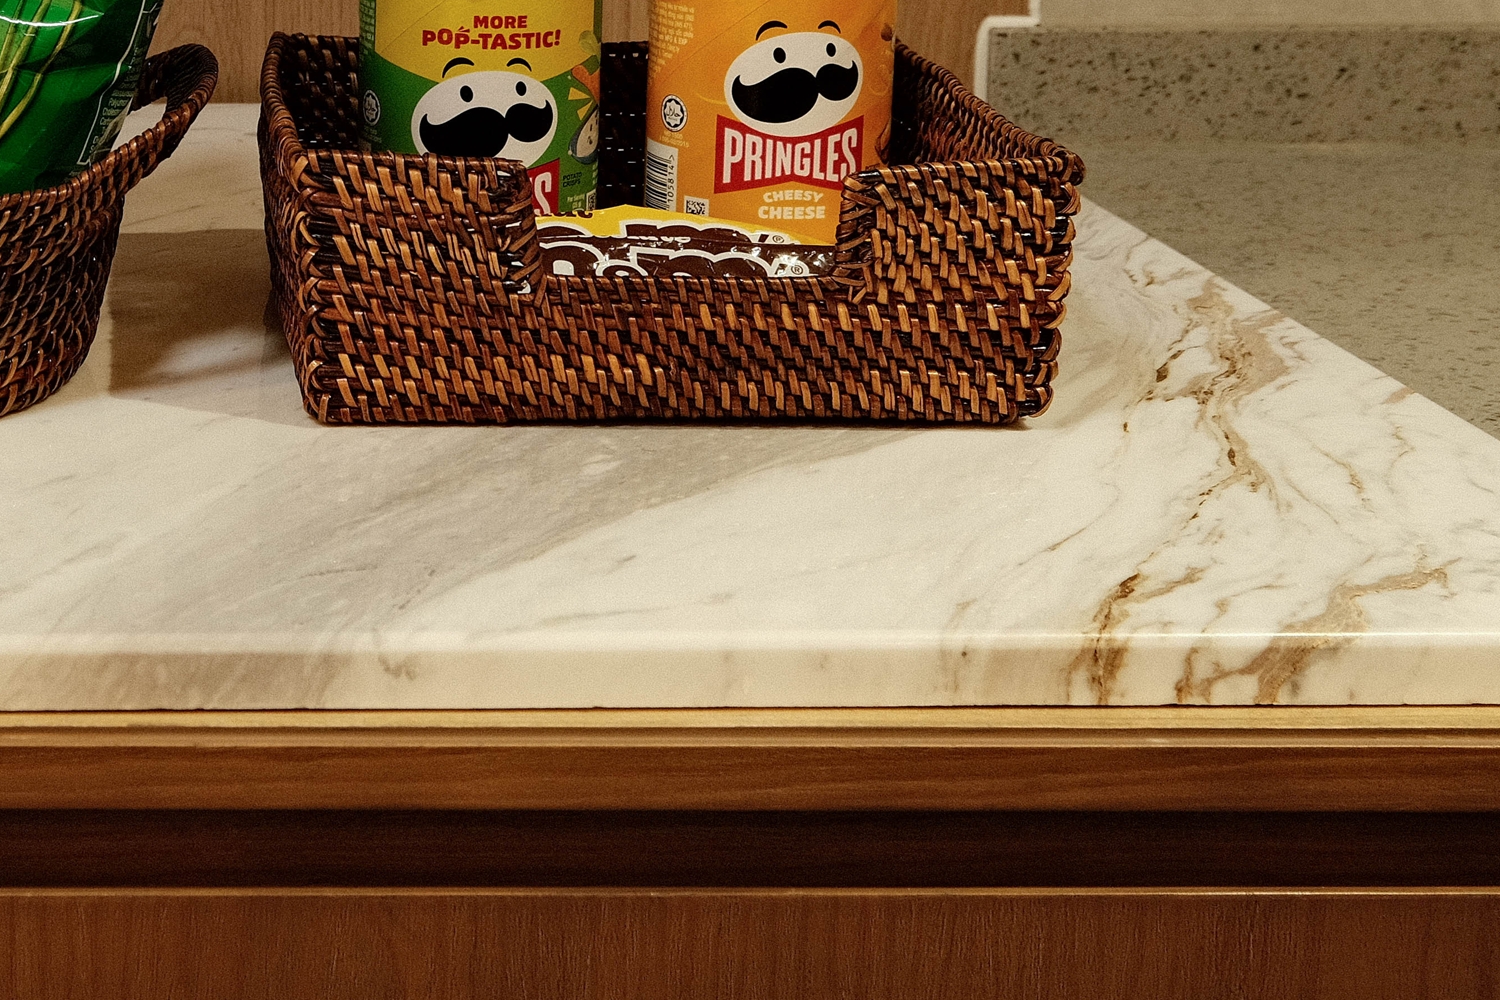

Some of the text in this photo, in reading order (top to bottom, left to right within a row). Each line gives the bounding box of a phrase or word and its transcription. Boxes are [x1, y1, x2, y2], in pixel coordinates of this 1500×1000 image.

[473, 15, 528, 29] MORE
[421, 26, 562, 50] POP-TASTIC!
[722, 127, 858, 185] PRINGLES
[562, 171, 583, 181] POTATO
[763, 189, 824, 204] CHEESY
[758, 205, 826, 220] CHEESE
